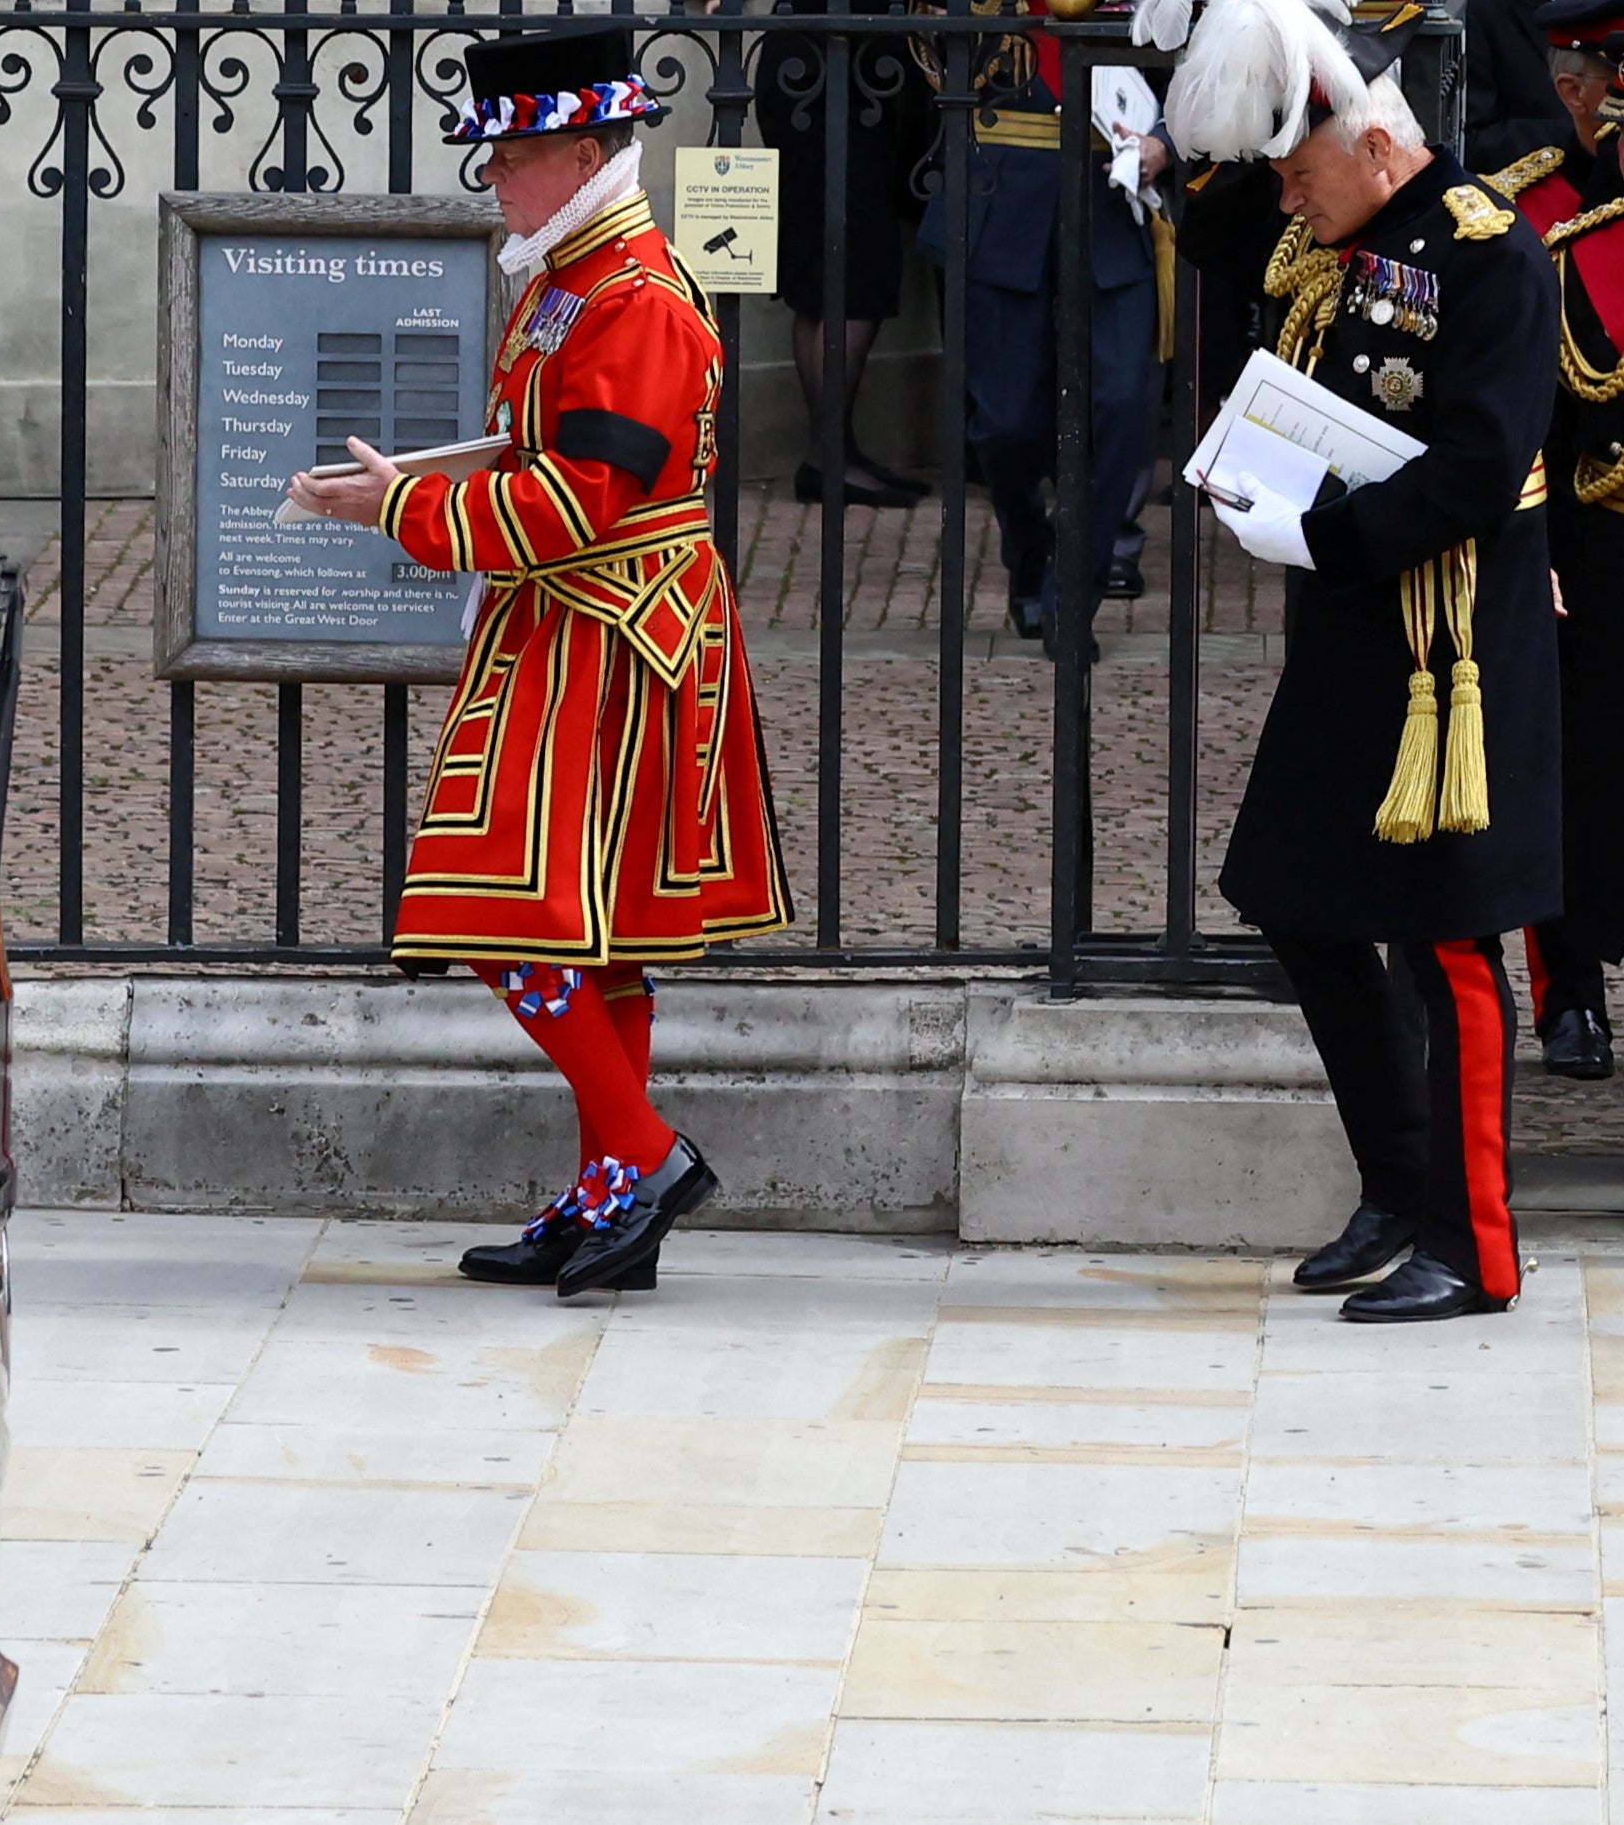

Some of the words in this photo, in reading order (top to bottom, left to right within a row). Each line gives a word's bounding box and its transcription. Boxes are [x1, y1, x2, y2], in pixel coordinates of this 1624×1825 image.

[686, 185, 709, 193] CCTV
[222, 248, 346, 283] Visiting
[355, 251, 444, 277] times
[413, 308, 442, 317] LAST
[396, 318, 459, 328] ADMISSION
[223, 333, 283, 353] Monday
[223, 360, 282, 380] Tuesday
[223, 389, 310, 409] Wednesday
[222, 417, 292, 437] Thursday
[221, 445, 267, 464] Friday
[221, 472, 286, 492] Saturday
[219, 504, 240, 515] The
[242, 506, 274, 519] Abbey
[219, 519, 272, 530] admission.
[305, 523, 322, 531] are
[325, 521, 341, 531] the
[219, 534, 242, 543] next
[275, 533, 305, 544] Times
[309, 537, 328, 547] may
[219, 551, 233, 561] All
[236, 554, 252, 562] are
[255, 553, 300, 563] welcome
[219, 567, 230, 575] to
[284, 567, 314, 577] which
[317, 567, 353, 578] follows
[356, 570, 366, 578] at
[397, 565, 450, 582] 3.00pm
[218, 584, 260, 598] Sunday
[263, 586, 271, 595] is
[274, 587, 319, 596] reserved
[322, 586, 337, 597] for
[383, 588, 401, 598] and
[405, 588, 431, 599] there
[435, 589, 442, 599] is
[218, 599, 252, 608] tourist
[292, 600, 306, 610] All
[310, 602, 326, 610] are
[329, 601, 374, 611] welcome
[392, 603, 435, 612] services
[218, 612, 247, 623] Enter
[250, 615, 261, 623] at
[264, 613, 282, 624] the
[285, 614, 315, 625] Great
[317, 614, 346, 625] West
[349, 615, 378, 625] Door
